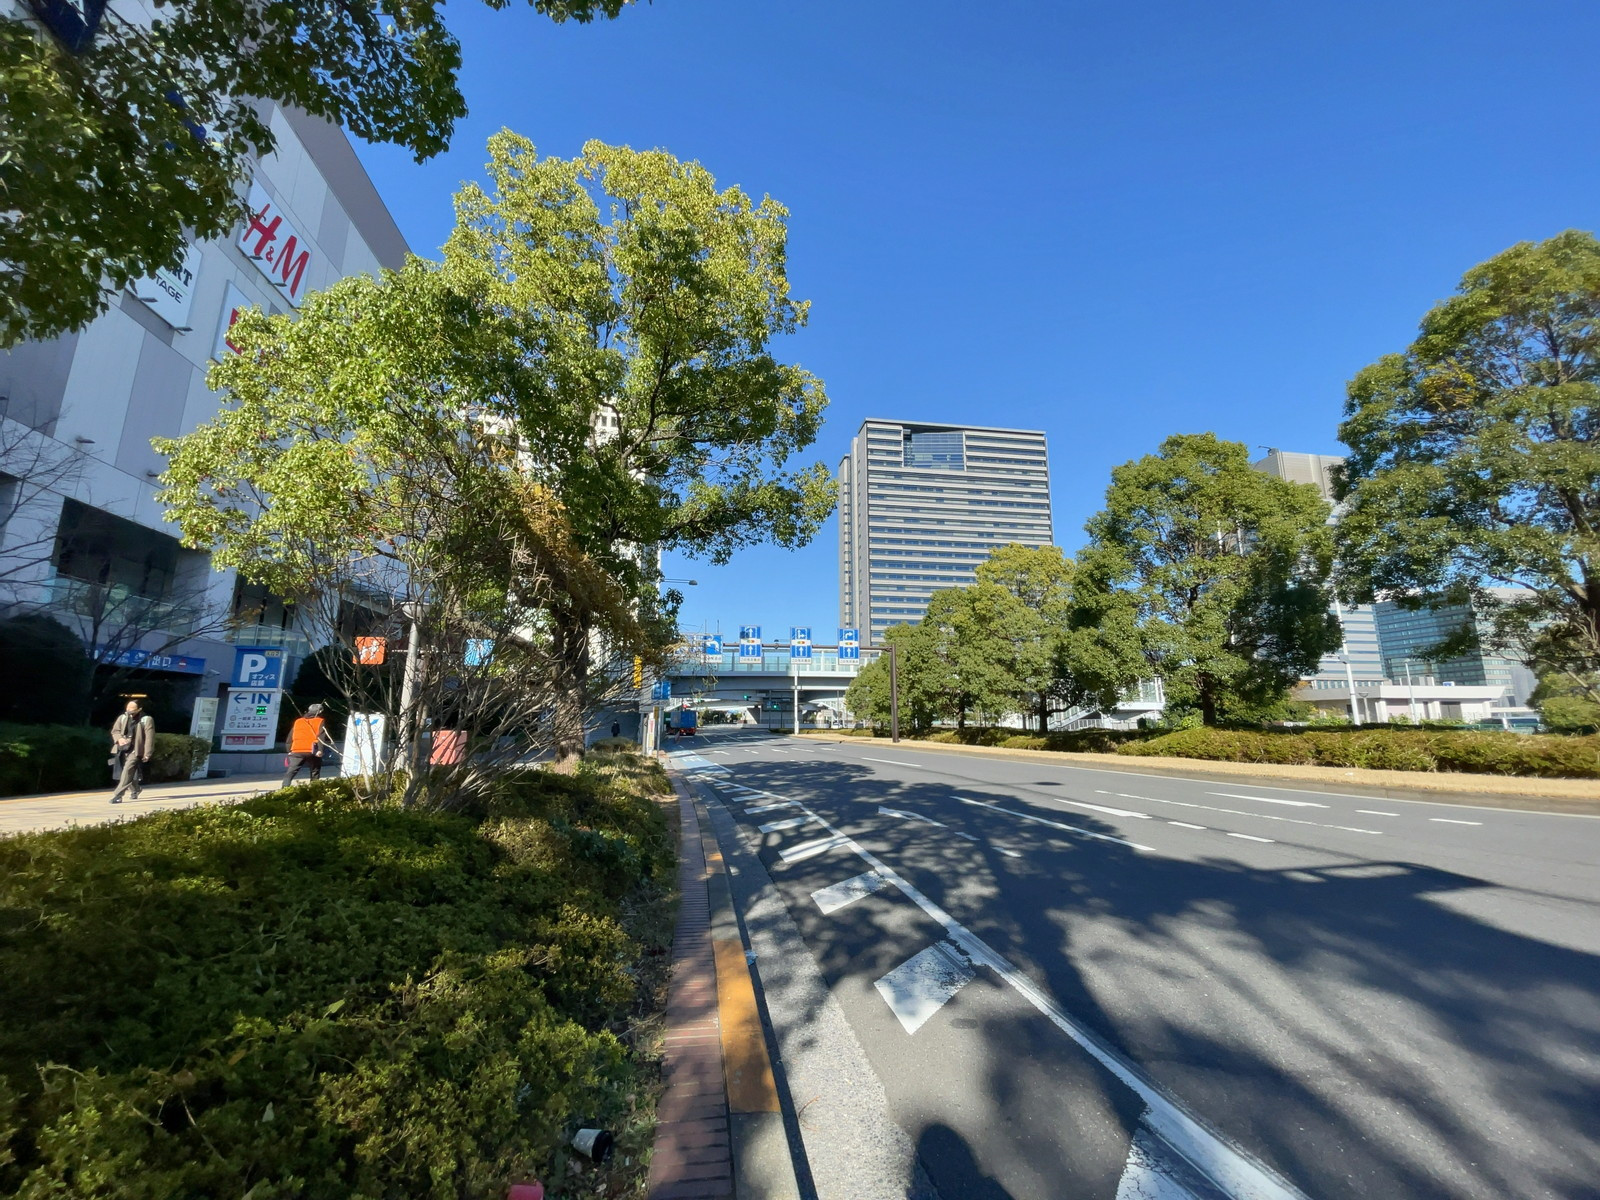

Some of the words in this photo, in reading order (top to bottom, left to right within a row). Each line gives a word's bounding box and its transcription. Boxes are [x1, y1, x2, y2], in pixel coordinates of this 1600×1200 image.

[242, 203, 310, 299] H&M
[155, 273, 183, 304] TAGE
[151, 655, 172, 668] 出口
[240, 653, 267, 682] P
[251, 693, 272, 704] IN
